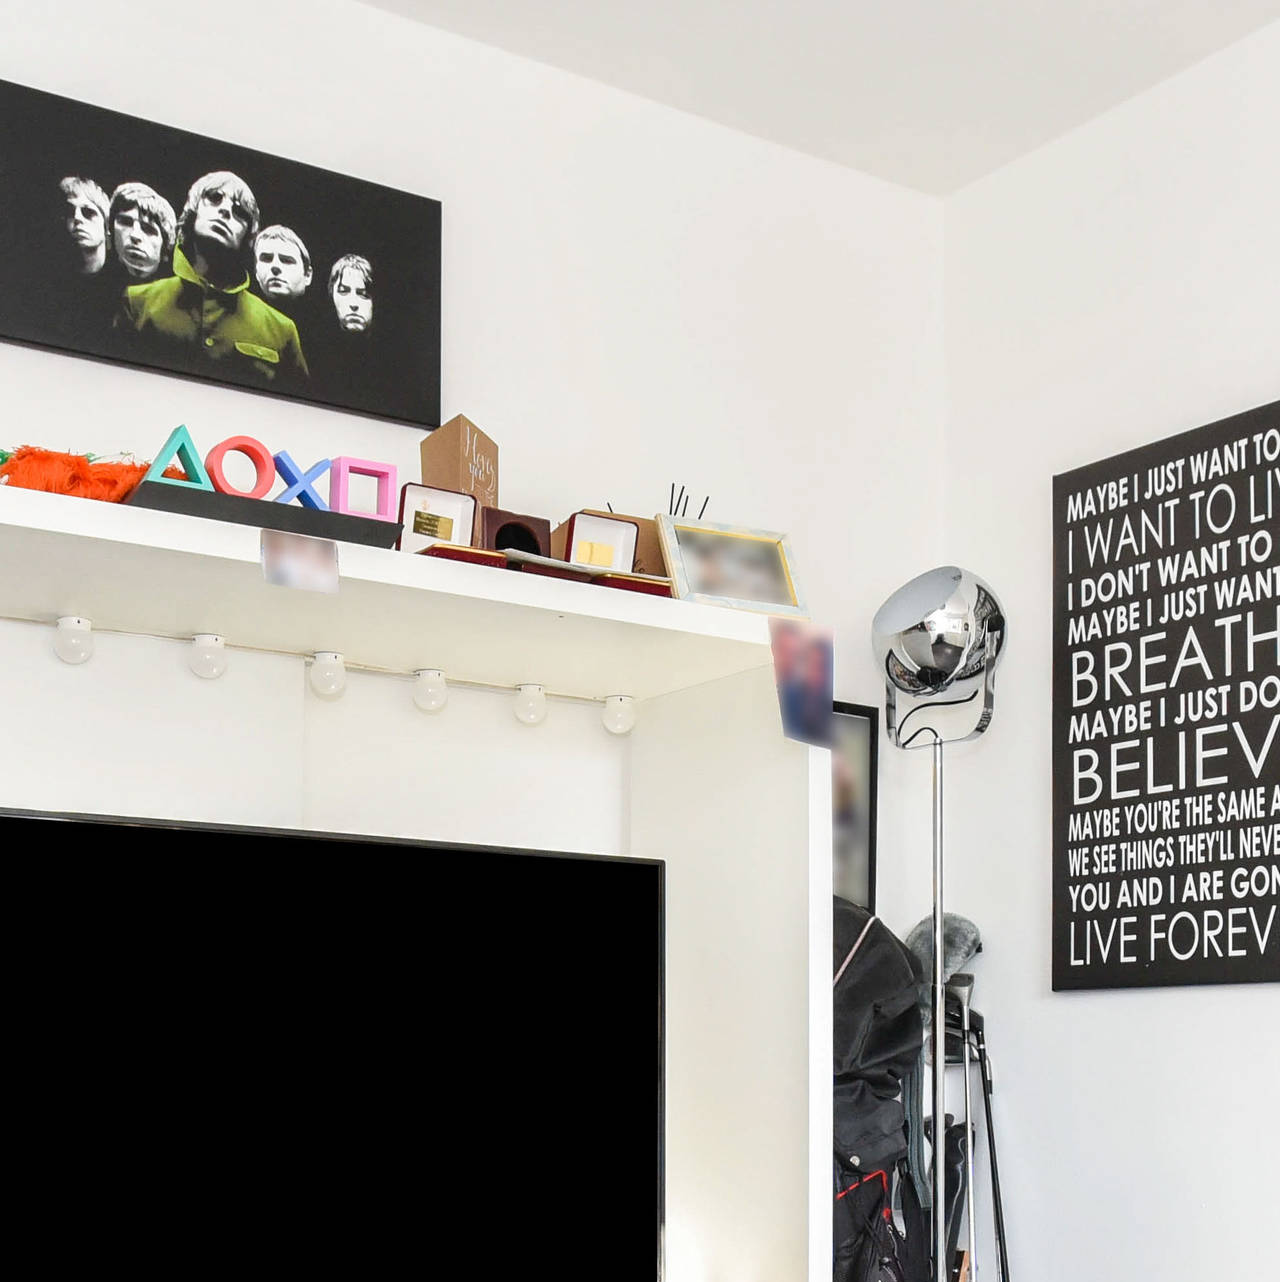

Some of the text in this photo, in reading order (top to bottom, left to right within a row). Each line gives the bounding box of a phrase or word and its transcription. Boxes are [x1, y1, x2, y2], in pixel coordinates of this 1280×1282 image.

[1067, 476, 1128, 523] MAYBE
[1134, 473, 1138, 503] I
[1144, 458, 1185, 499] JUST
[1190, 438, 1247, 484] WANT
[1253, 428, 1280, 465] TO
[1068, 530, 1073, 574] I
[1084, 498, 1180, 568] WANT
[1189, 483, 1236, 540] TO
[1068, 583, 1073, 610] I
[1081, 562, 1150, 608] DON'T
[1158, 540, 1231, 587] WANT
[1238, 529, 1272, 566] TO
[1068, 601, 1140, 646] MAYBE
[1147, 598, 1152, 627] I
[1159, 585, 1207, 624] JUST
[1068, 700, 1151, 744] MAYBE
[1160, 697, 1165, 727] I
[1174, 685, 1231, 725] JUST
[1068, 807, 1120, 842] MAYBE
[1124, 798, 1180, 834] YOU'RE
[1184, 794, 1213, 825] THE
[1217, 786, 1265, 823] SAME
[1068, 847, 1089, 877] WE
[1093, 842, 1116, 874] SEE
[1120, 836, 1174, 871] THINGS
[1179, 830, 1234, 865] THEY'LL
[1068, 882, 1110, 912] YOU
[1117, 877, 1163, 909] AND
[1170, 875, 1175, 904] I
[1182, 870, 1223, 902] ARE
[1070, 916, 1137, 966] LIVE
